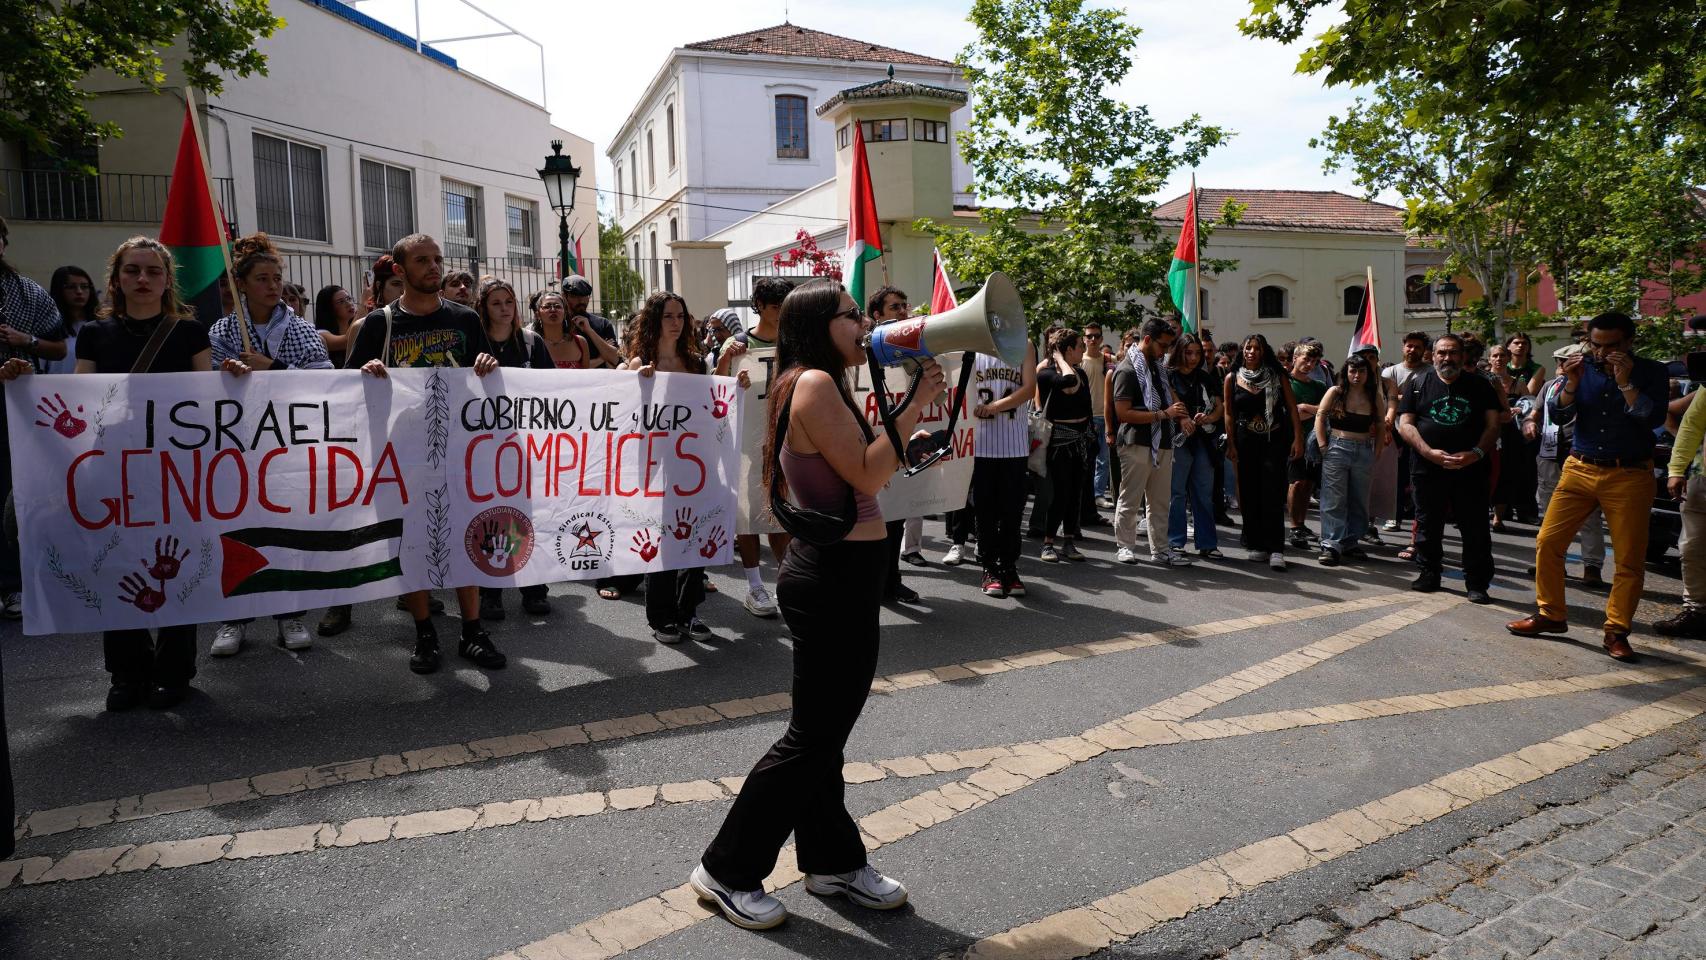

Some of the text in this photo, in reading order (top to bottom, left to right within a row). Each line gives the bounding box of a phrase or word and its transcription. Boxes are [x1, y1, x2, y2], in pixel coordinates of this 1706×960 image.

[145, 399, 358, 453] ISRAEL
[590, 401, 620, 432] UE
[642, 403, 692, 433] UGR
[66, 441, 409, 531] GENOCIDA
[465, 431, 707, 503] CÓMPLICES
[558, 511, 594, 533] Sindical
[571, 559, 600, 571] USE
